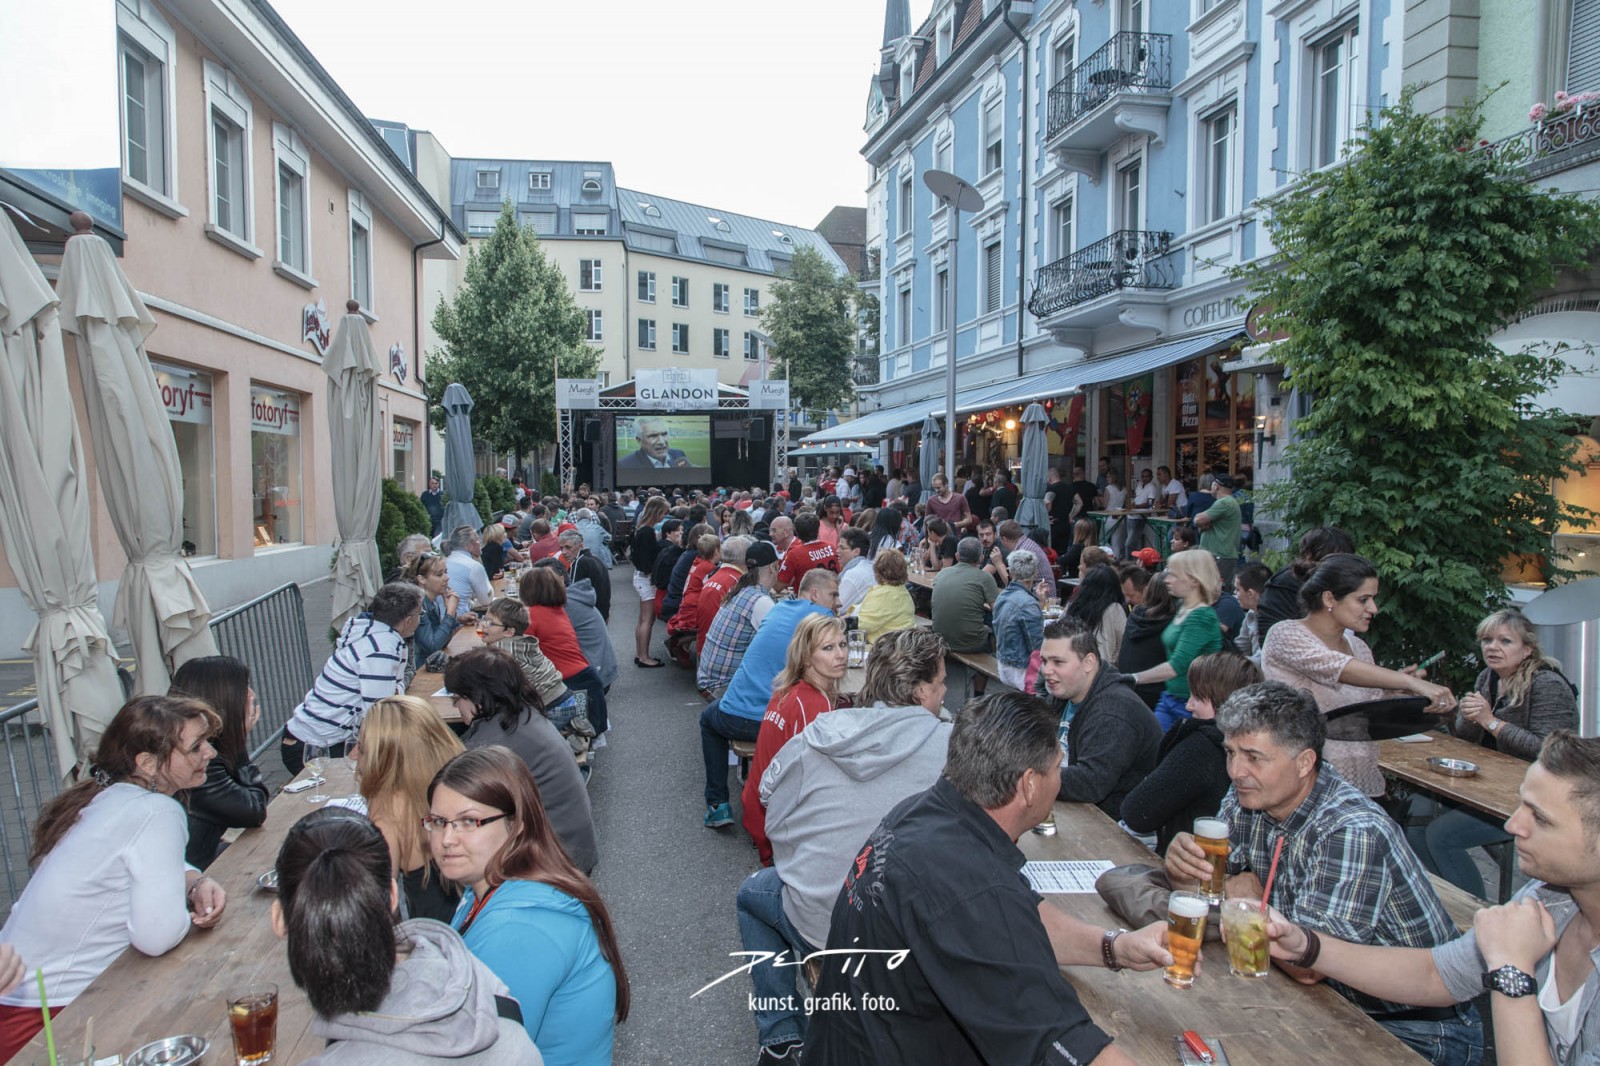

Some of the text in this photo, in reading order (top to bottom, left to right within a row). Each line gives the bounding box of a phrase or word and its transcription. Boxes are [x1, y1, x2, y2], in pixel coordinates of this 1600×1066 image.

[156, 378, 194, 416] oryf
[640, 388, 713, 400] GLANDON
[251, 396, 288, 430] fotoryf
[808, 545, 834, 561] SUISSE
[763, 710, 786, 731] UISSE
